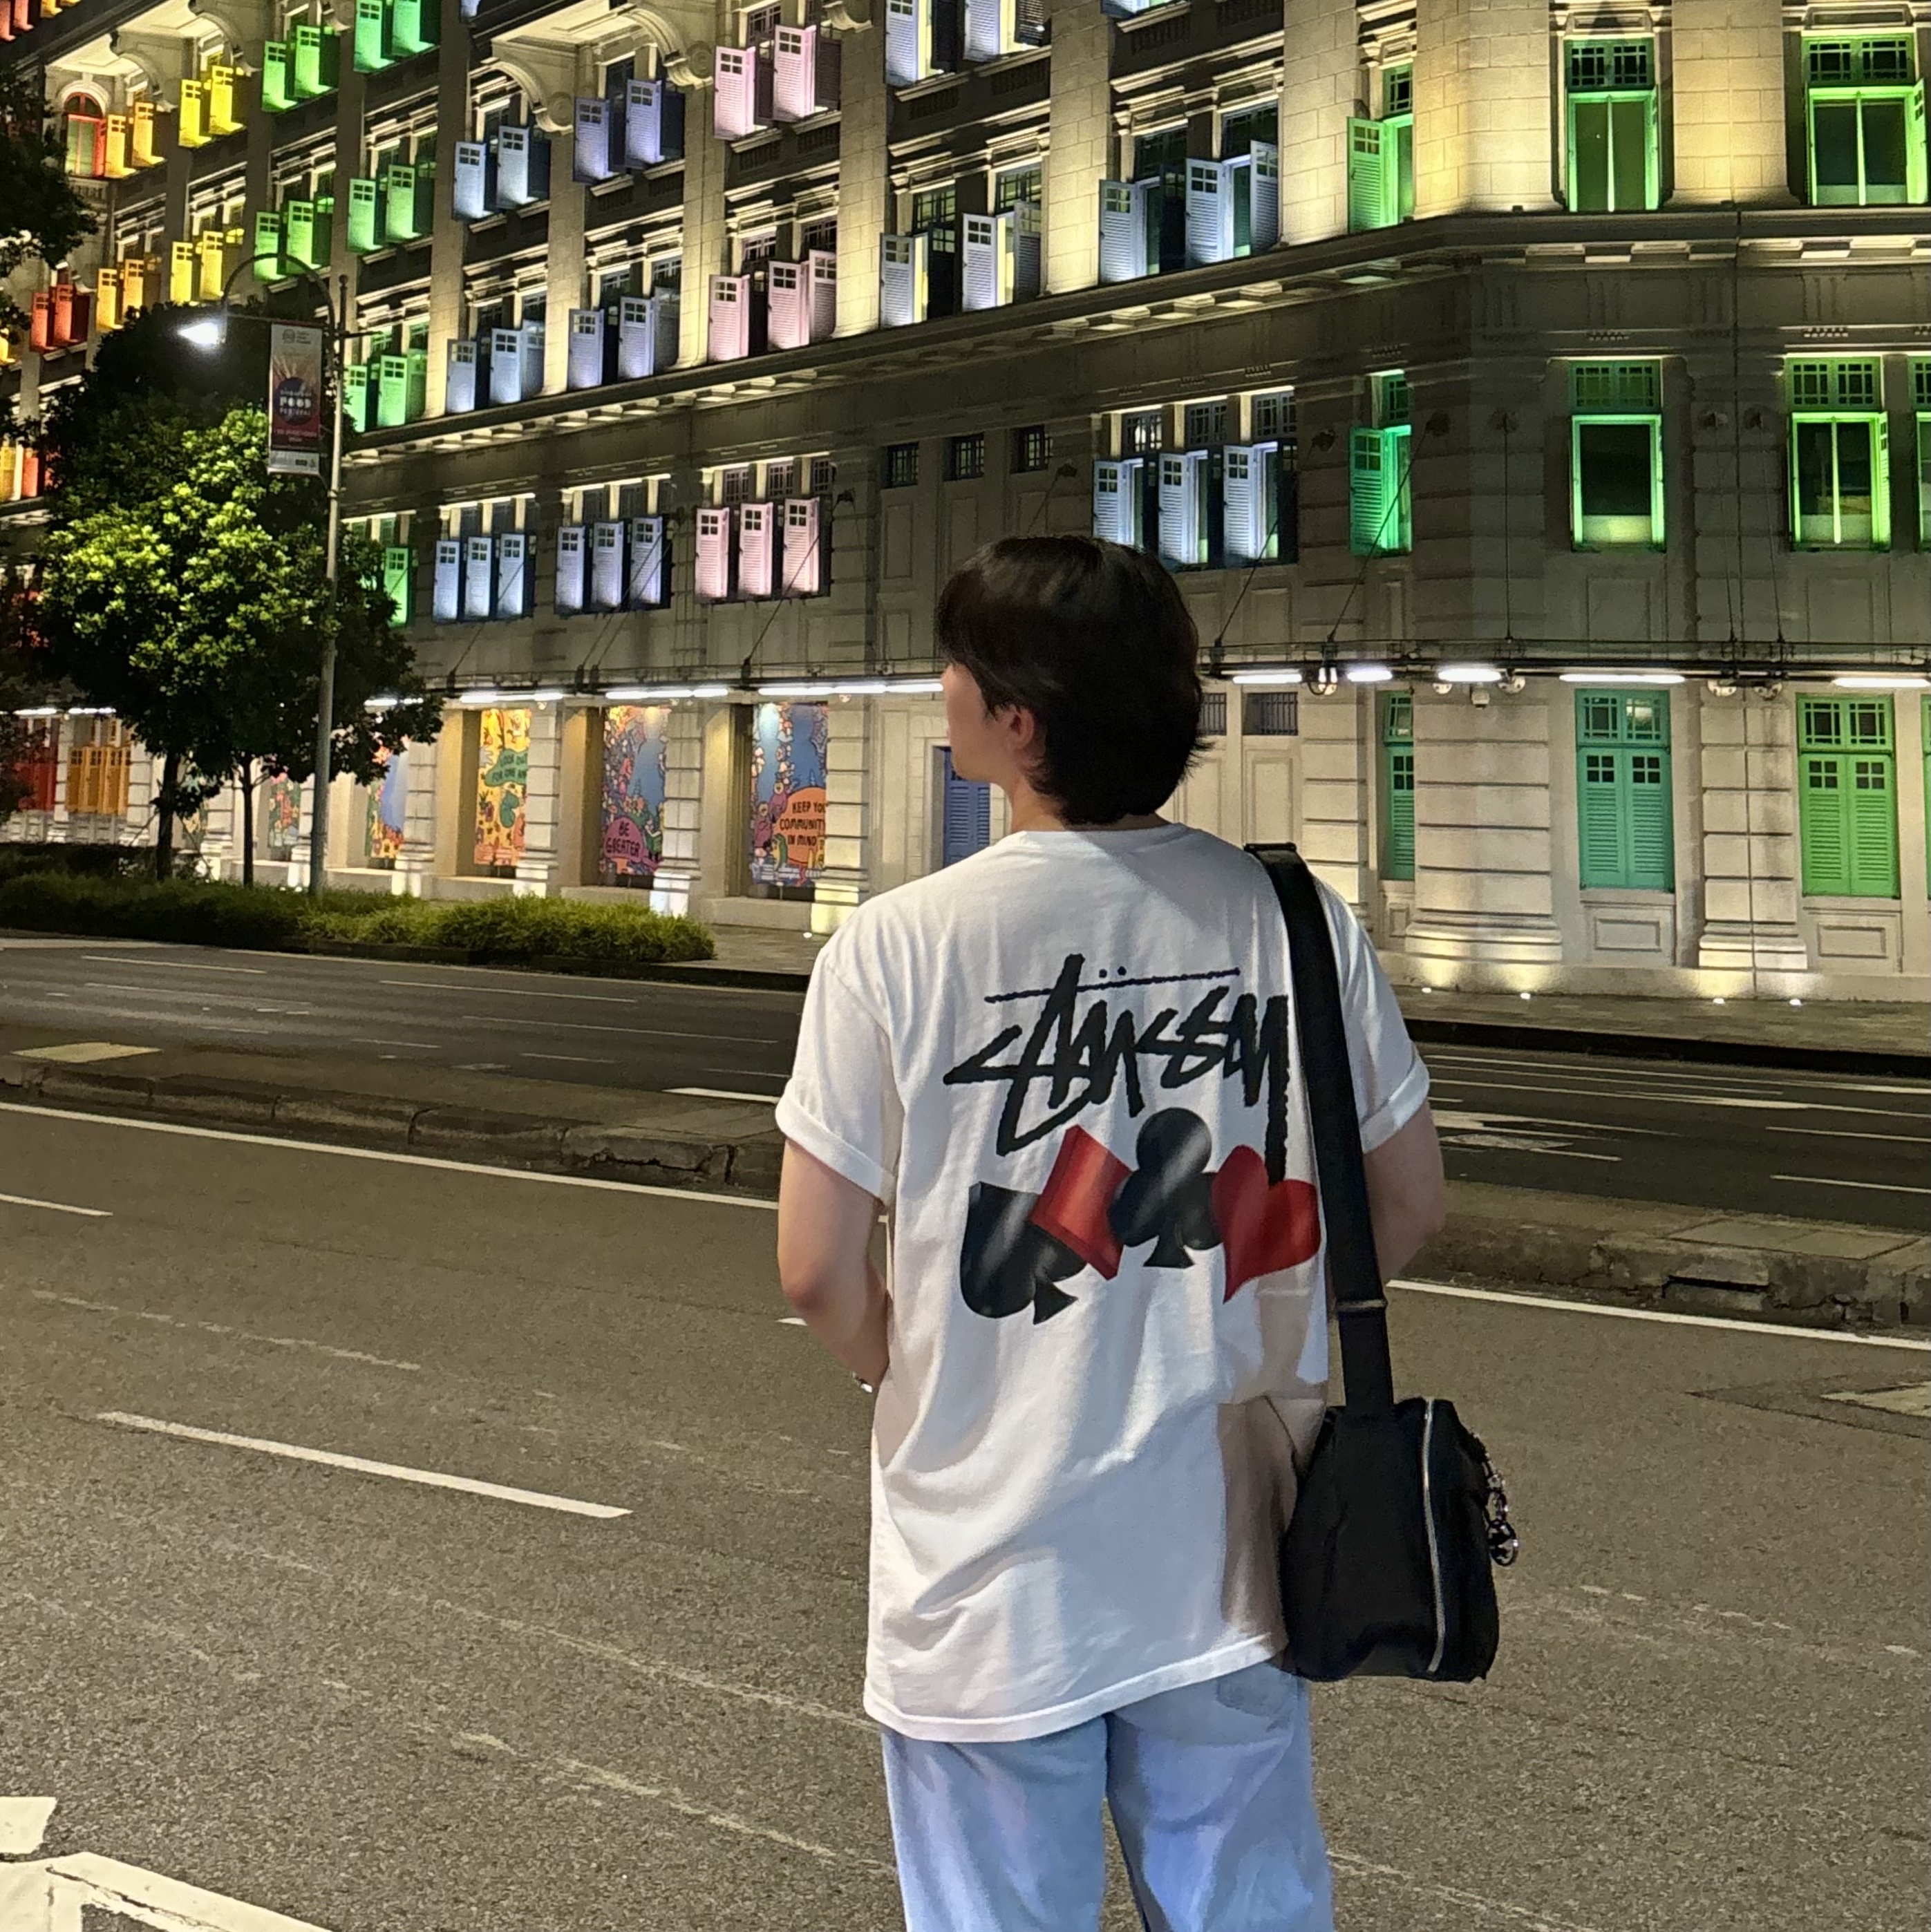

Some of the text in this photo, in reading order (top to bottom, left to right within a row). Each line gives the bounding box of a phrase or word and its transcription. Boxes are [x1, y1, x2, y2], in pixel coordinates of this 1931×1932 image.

[792, 801, 811, 813] KEEP
[619, 820, 630, 837] BE
[606, 837, 640, 858] GREATER
[787, 835, 817, 846] IN MIND
